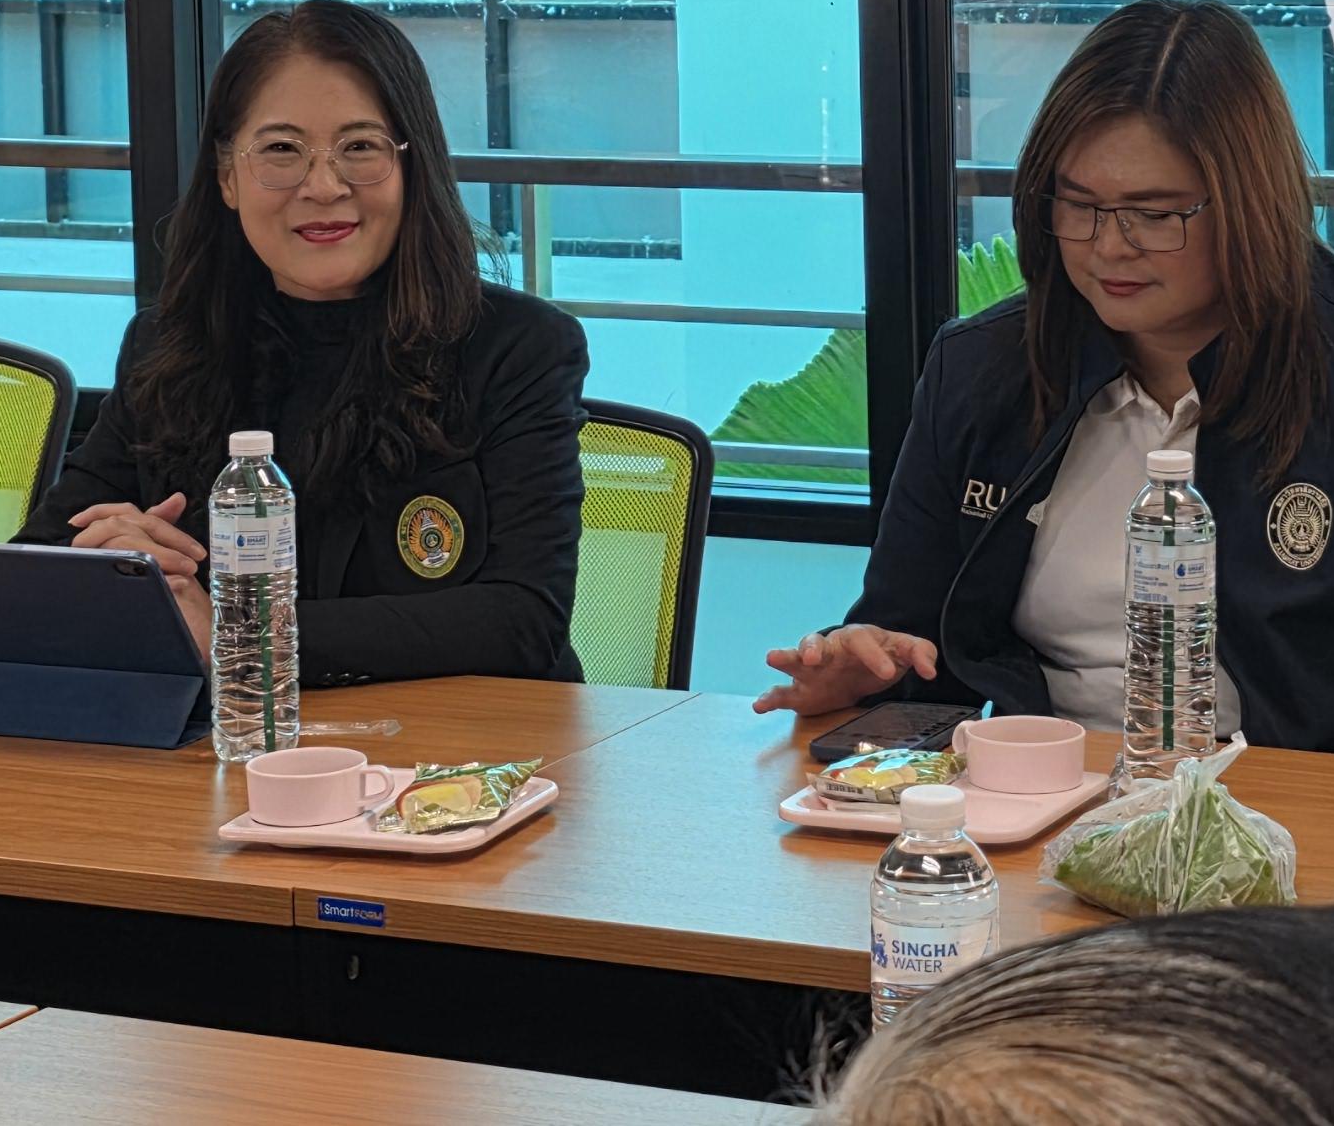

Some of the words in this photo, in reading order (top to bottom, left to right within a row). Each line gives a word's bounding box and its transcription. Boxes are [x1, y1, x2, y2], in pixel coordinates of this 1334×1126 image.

[963, 479, 1007, 511] RU
[891, 939, 959, 958] SINGHA
[892, 955, 943, 973] WATER
